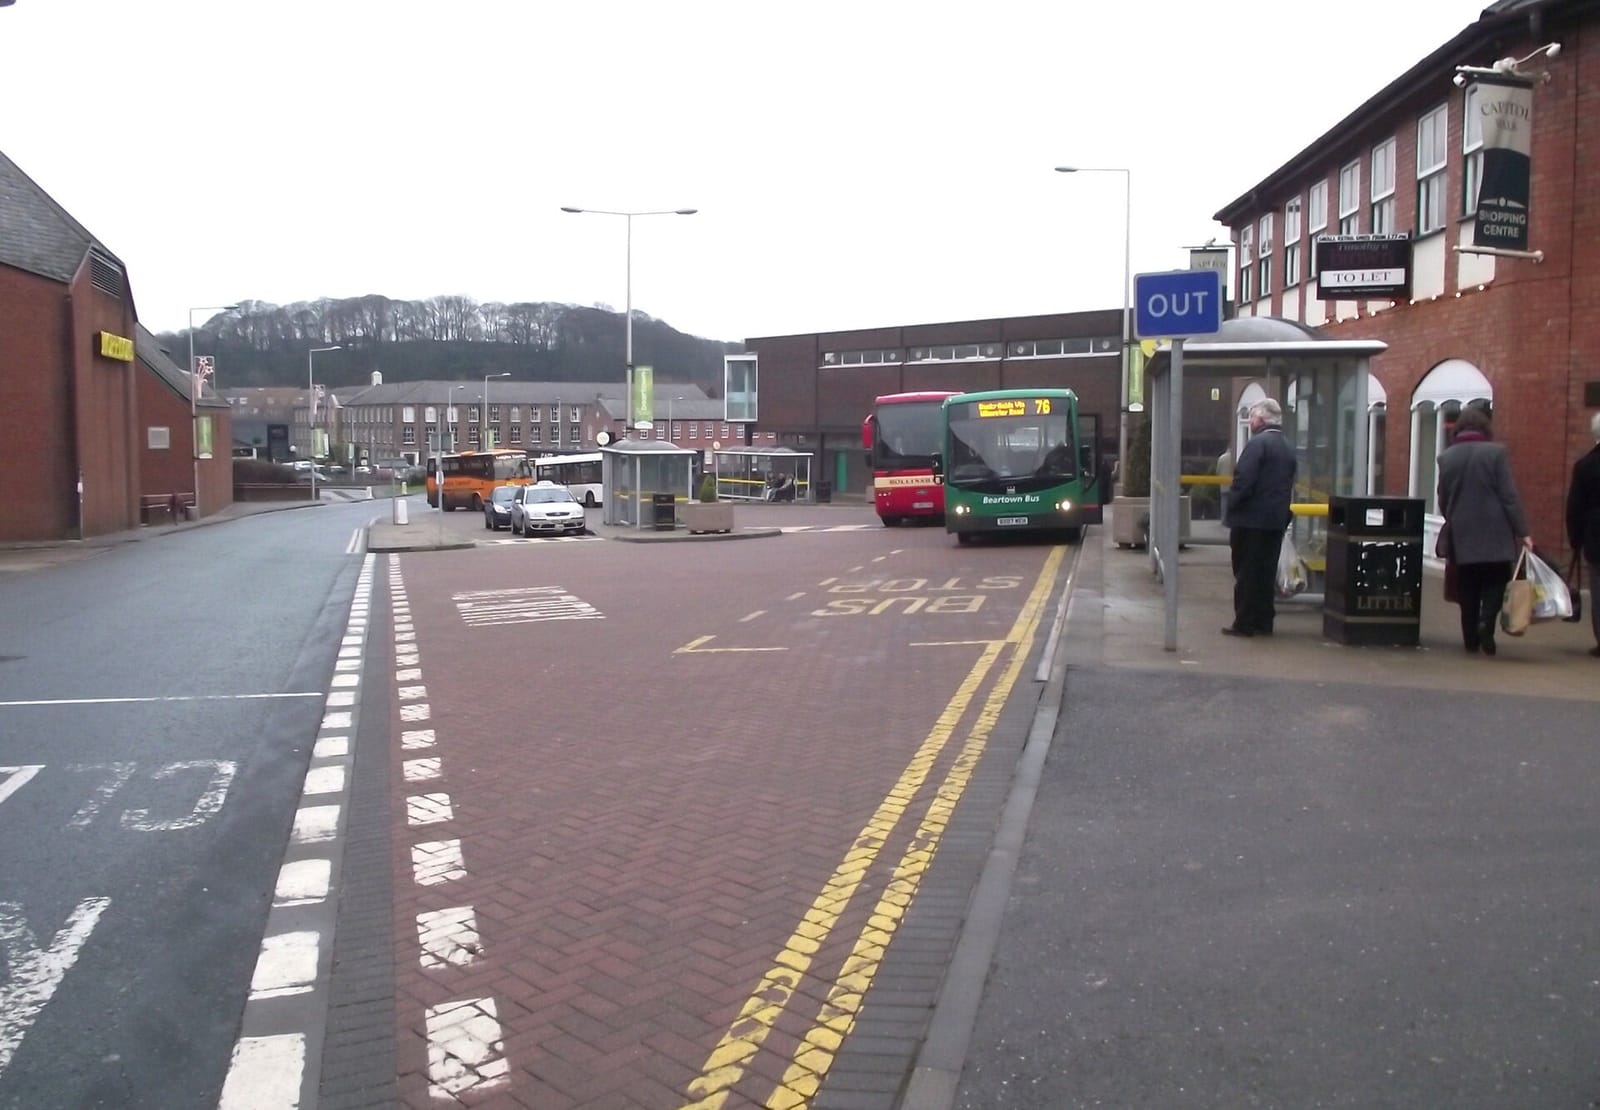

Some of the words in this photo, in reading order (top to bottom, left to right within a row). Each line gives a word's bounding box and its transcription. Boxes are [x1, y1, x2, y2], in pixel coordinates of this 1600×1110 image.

[1481, 101, 1530, 121] CAPITOL
[1479, 211, 1526, 225] SHOPPING
[1483, 224, 1520, 238] CENTRE
[1333, 272, 1356, 283] TO
[1360, 271, 1391, 282] LET
[1148, 291, 1208, 318] OUT
[1035, 399, 1051, 415] 76
[983, 496, 1022, 504] Beartown
[1024, 494, 1040, 503] Bus
[827, 576, 1024, 593] STOP
[811, 595, 987, 617] BUS
[1357, 595, 1414, 610] LITTER
